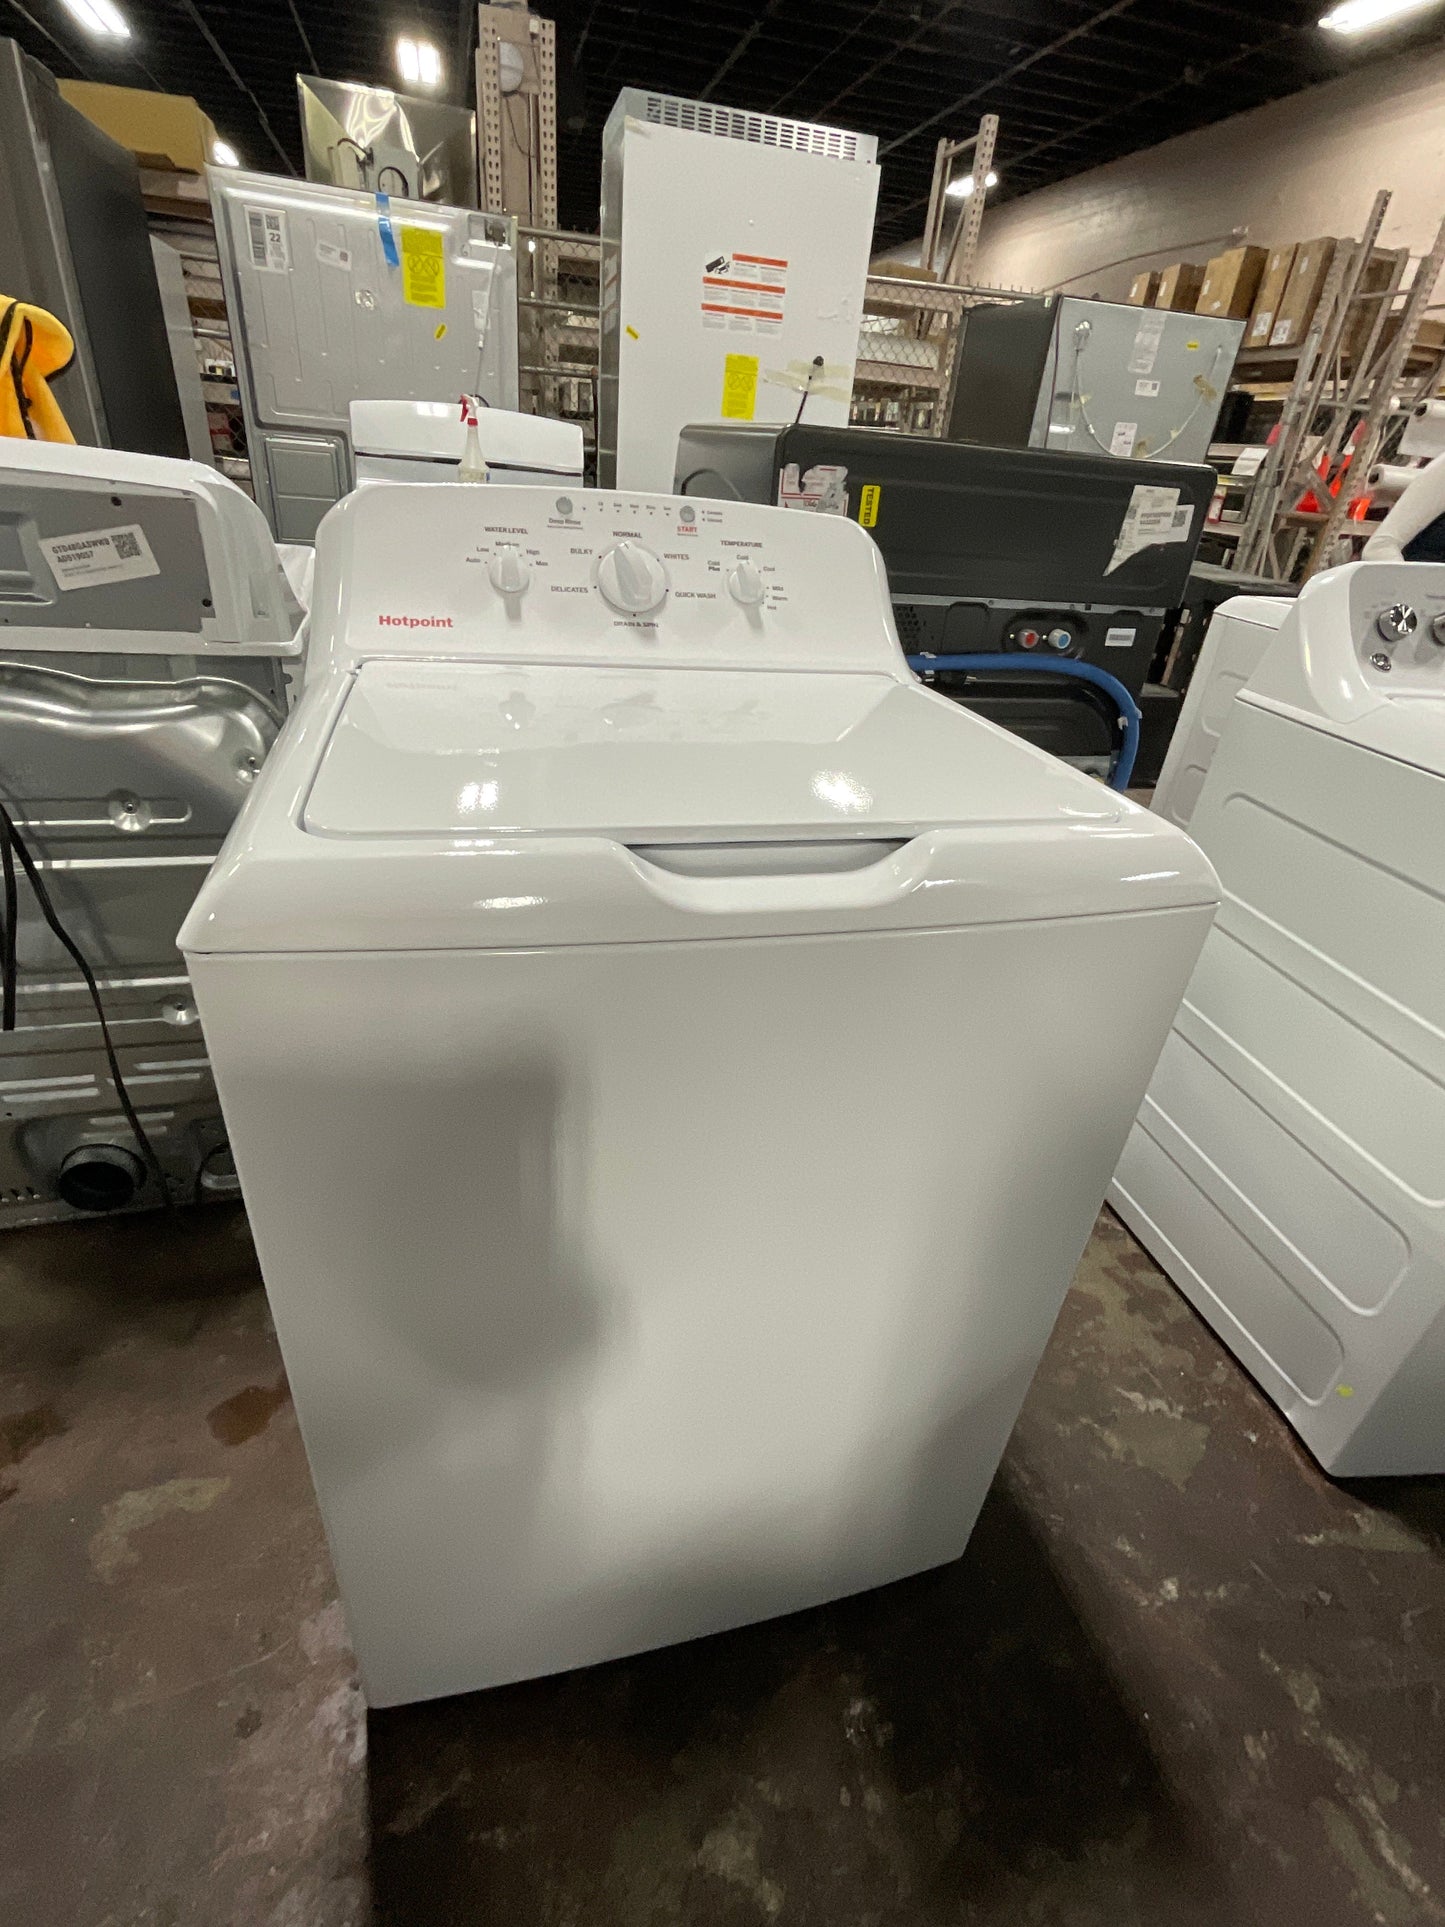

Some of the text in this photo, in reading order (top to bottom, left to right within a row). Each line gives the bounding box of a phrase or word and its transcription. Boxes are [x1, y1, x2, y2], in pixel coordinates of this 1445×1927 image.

[269, 232, 281, 243] 22
[863, 487, 875, 525] TESTED
[378, 615, 454, 629] Hotpoint
